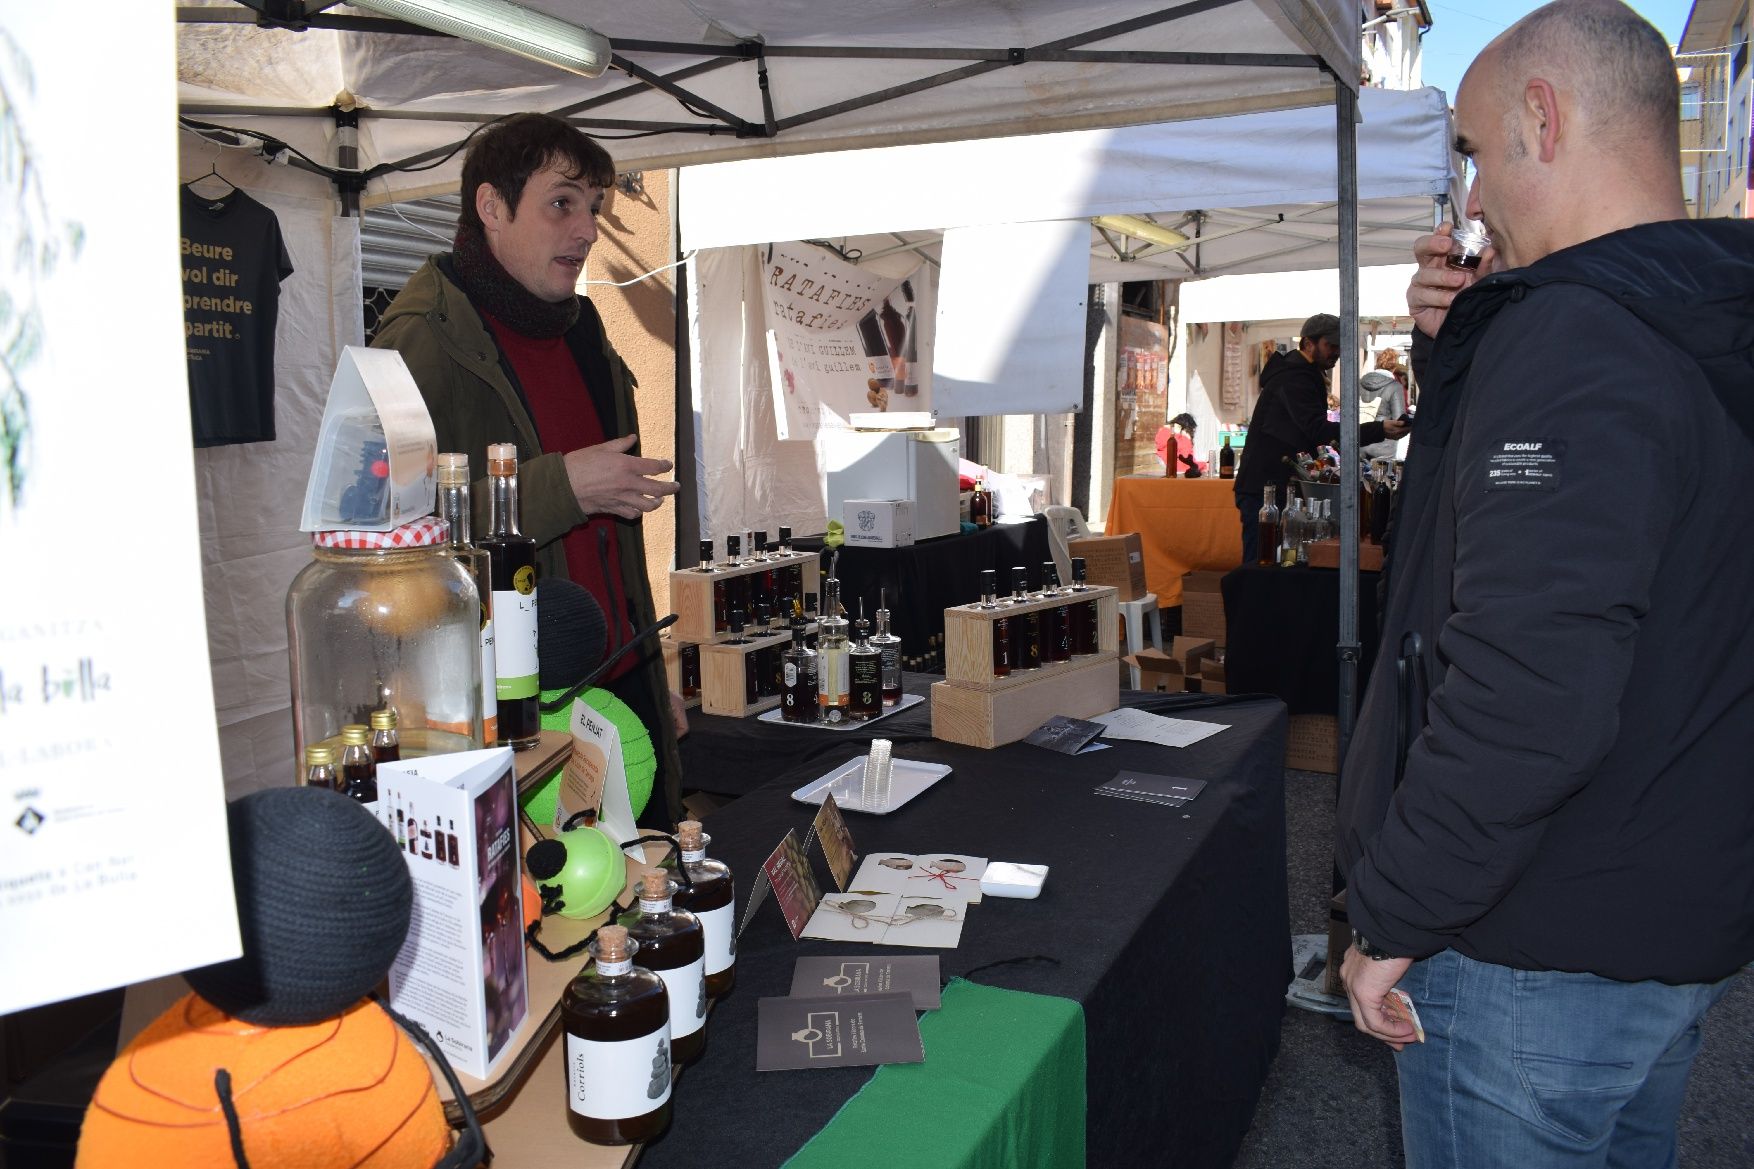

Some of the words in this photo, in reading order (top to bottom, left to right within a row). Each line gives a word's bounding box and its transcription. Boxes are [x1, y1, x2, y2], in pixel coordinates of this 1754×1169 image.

[180, 238, 233, 261] Beure
[182, 266, 207, 284] vol
[212, 269, 239, 287] dir
[770, 265, 871, 312] RATAFIES
[183, 295, 252, 315] prendre
[773, 300, 848, 330] ratafies
[823, 361, 862, 374] guillem
[1002, 651, 1008, 665] 1
[1031, 644, 1038, 657] 8
[786, 693, 794, 706] 8
[487, 827, 511, 860] RATAFIES
[576, 1053, 586, 1102] Corriols
